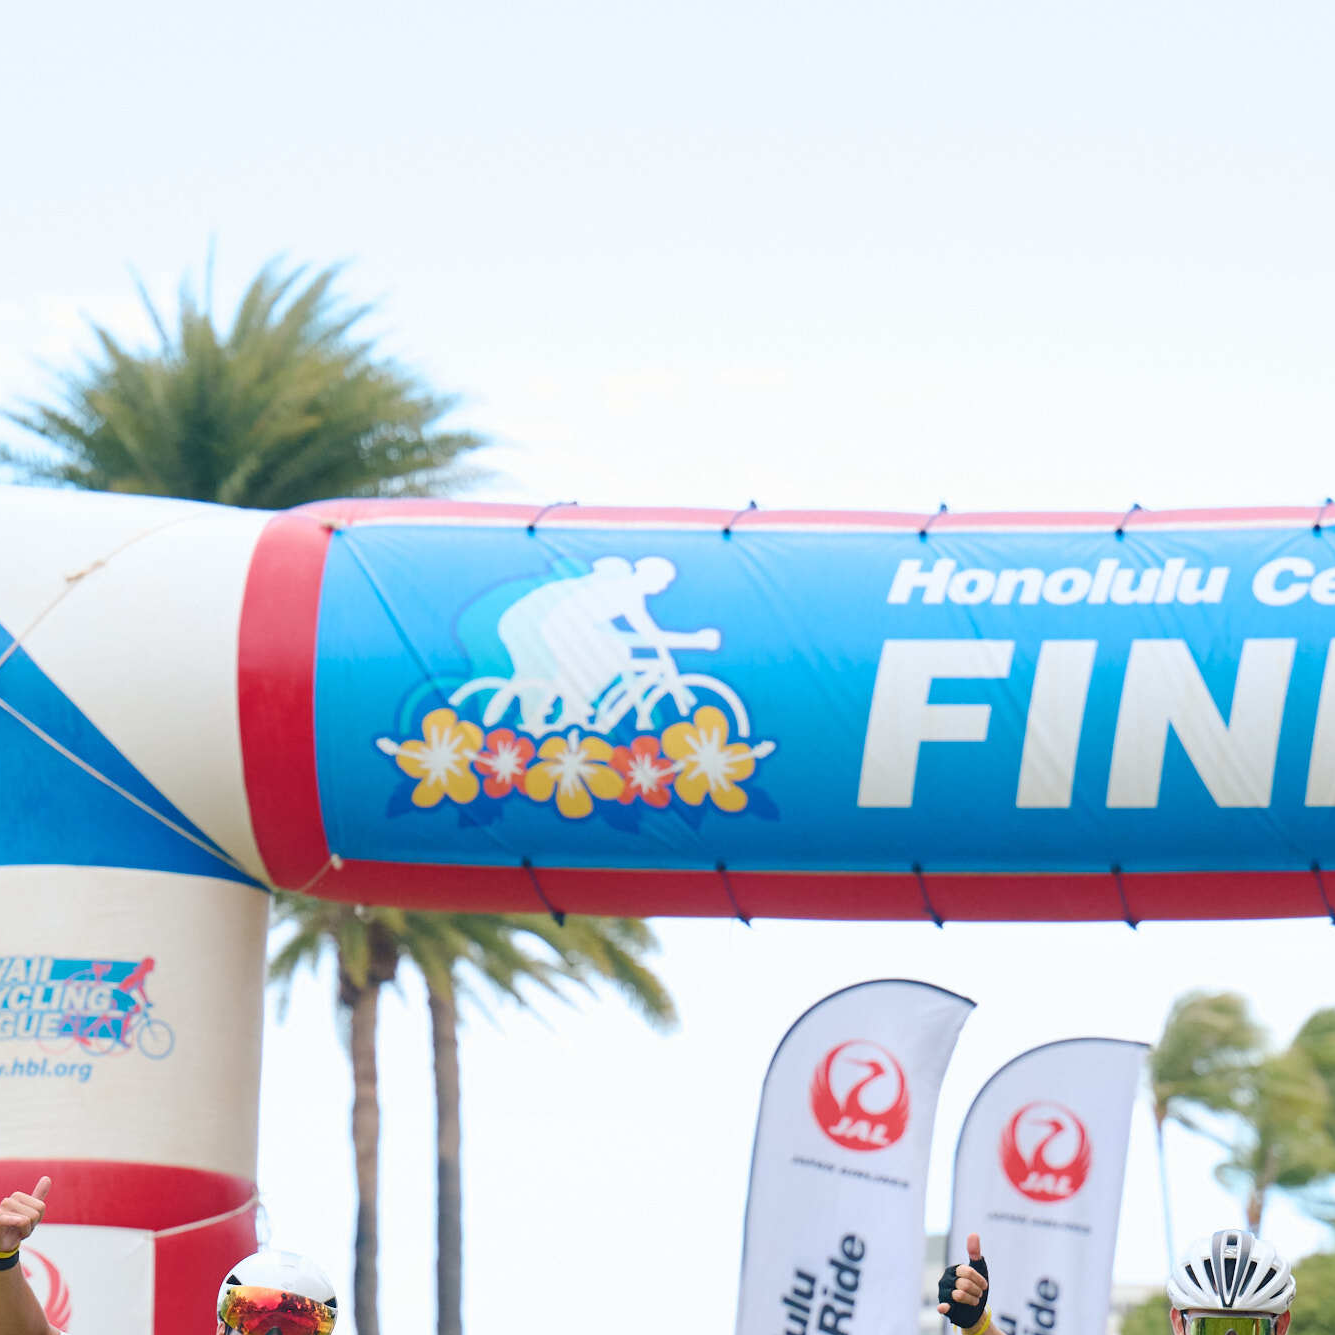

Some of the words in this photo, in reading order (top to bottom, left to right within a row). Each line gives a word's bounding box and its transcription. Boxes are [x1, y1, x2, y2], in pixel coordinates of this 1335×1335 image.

[886, 556, 1230, 606] Honolulu
[827, 1115, 891, 1148] JAL
[1018, 1170, 1076, 1197] JAL
